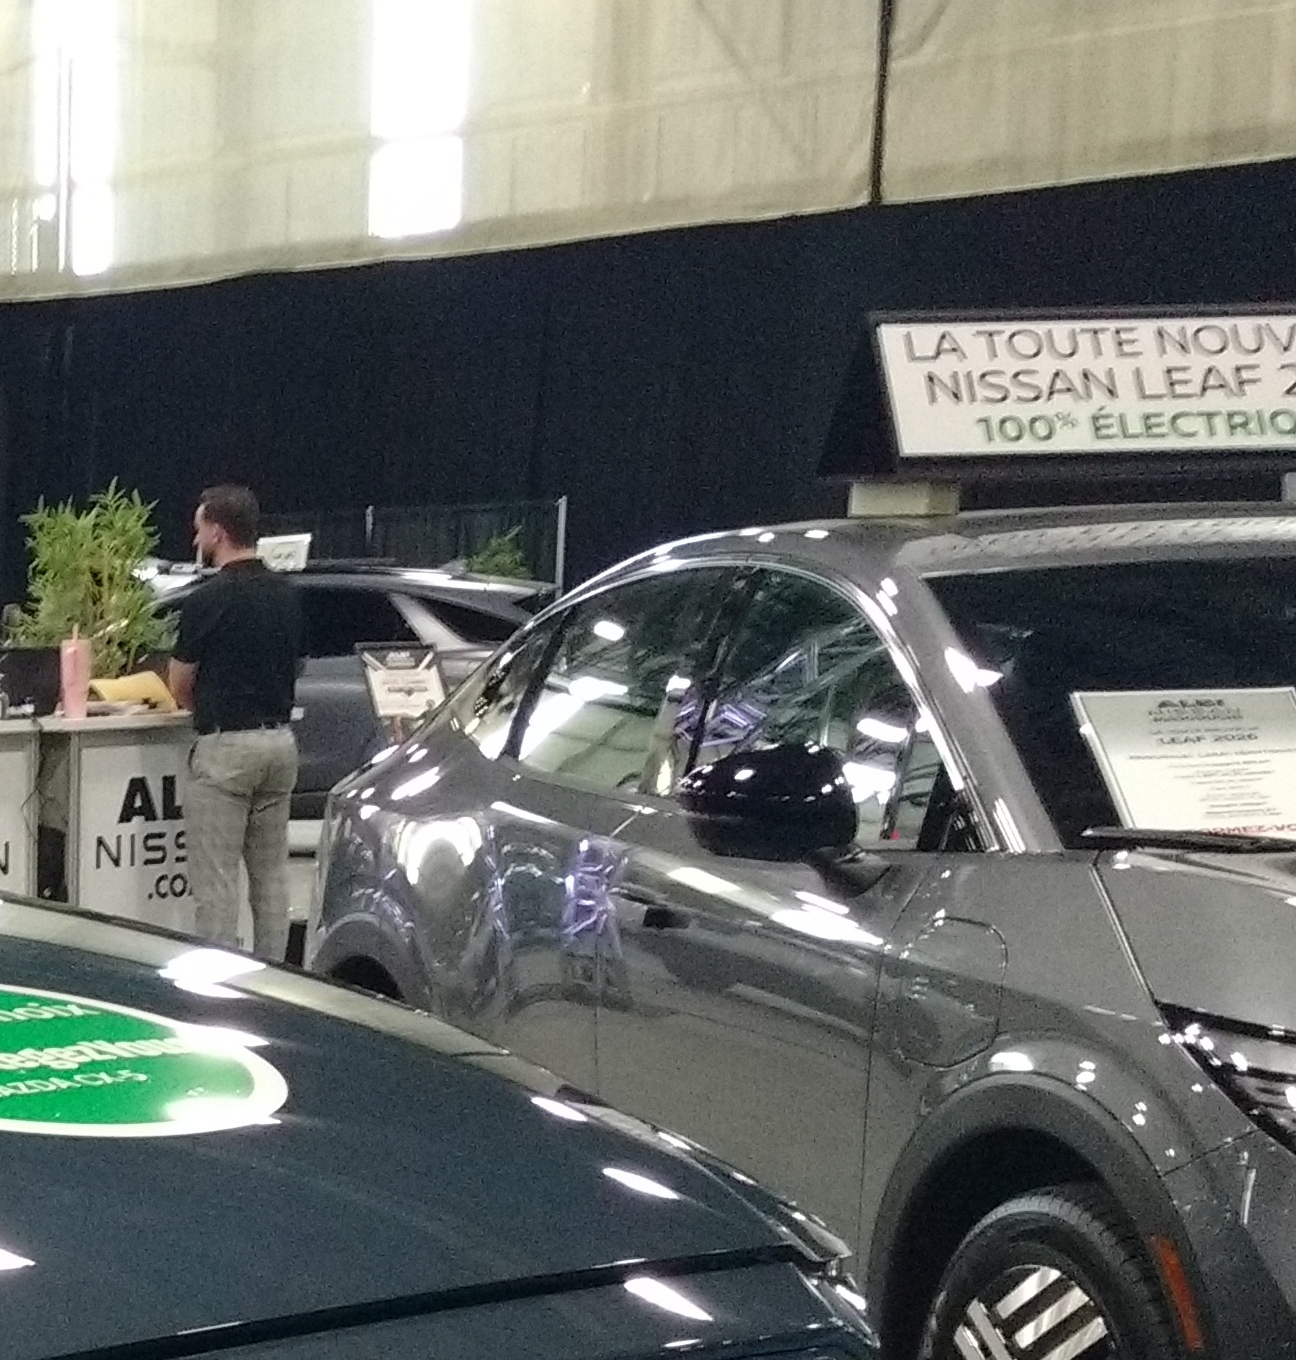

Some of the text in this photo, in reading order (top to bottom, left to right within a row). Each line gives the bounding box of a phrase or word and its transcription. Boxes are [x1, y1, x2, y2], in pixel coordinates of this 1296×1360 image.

[903, 330, 968, 363] LA
[973, 327, 1143, 362] TOUTE
[925, 367, 1118, 405] NISSAN
[1133, 364, 1262, 401] LEAF
[977, 411, 1078, 443] 100%
[117, 775, 185, 824] AL
